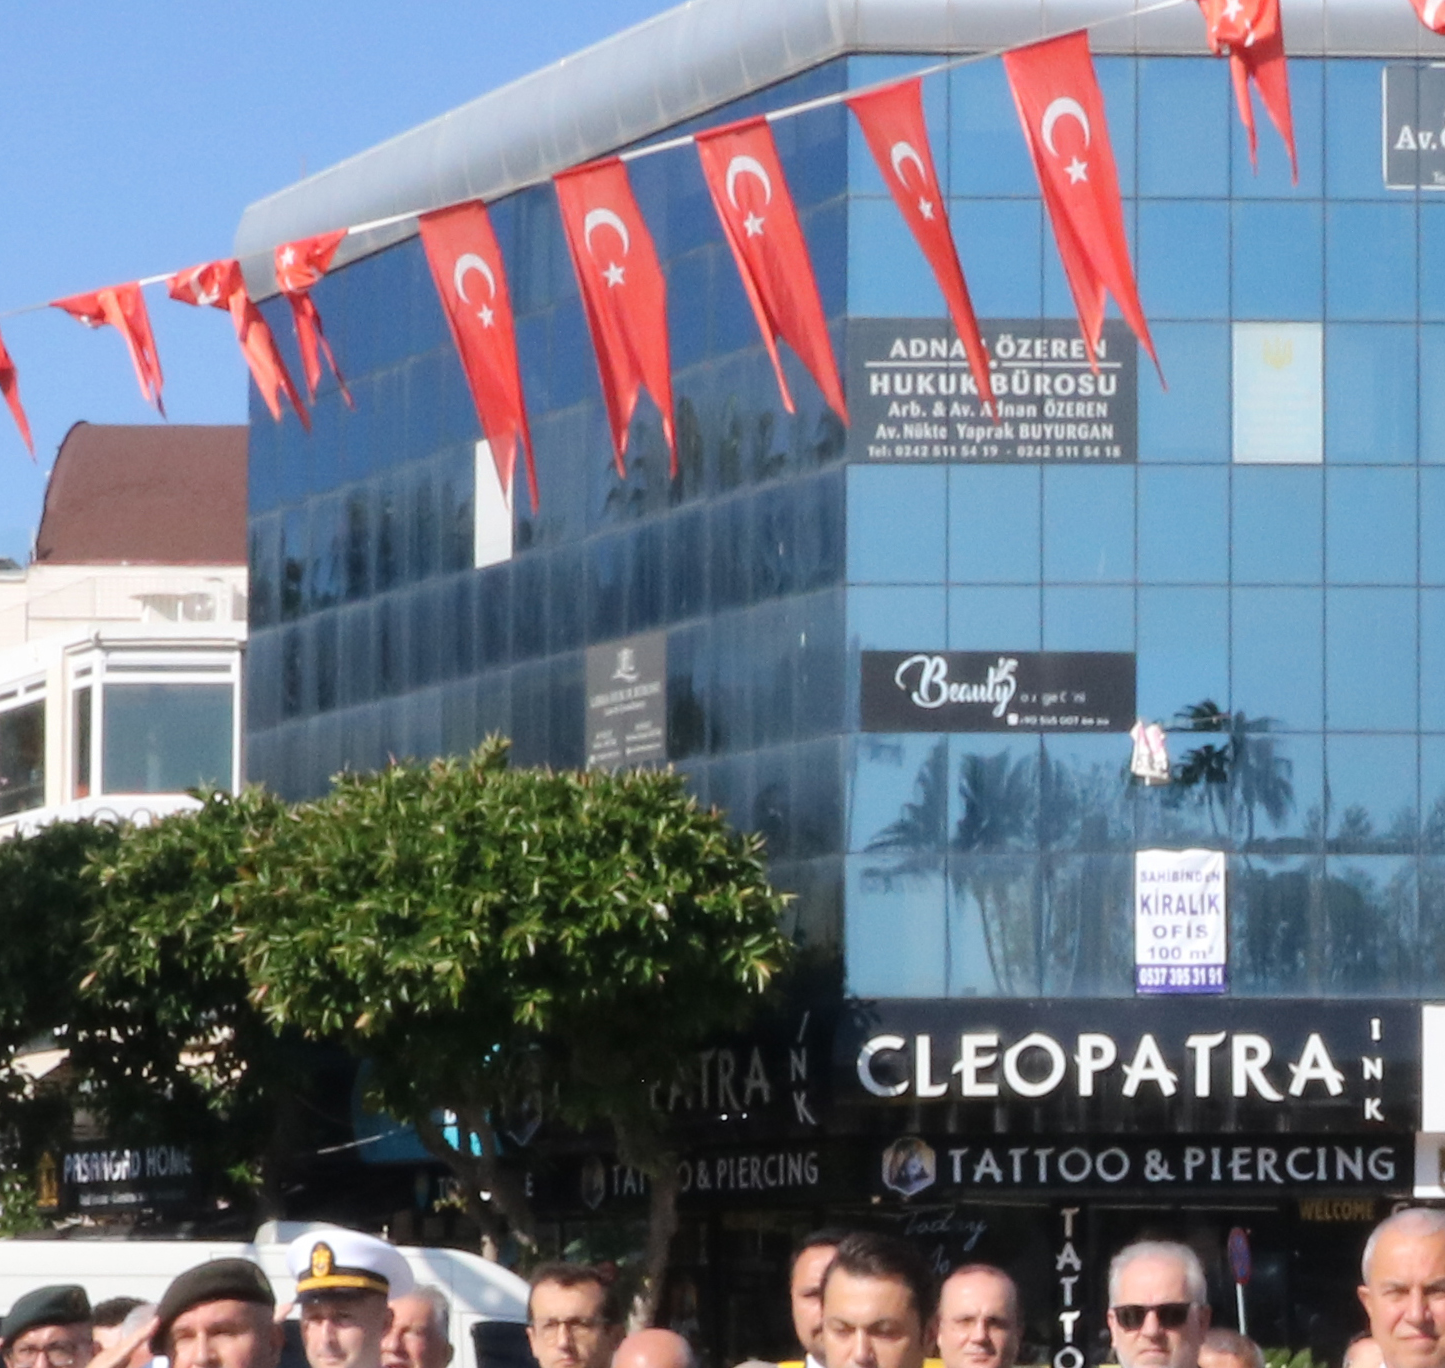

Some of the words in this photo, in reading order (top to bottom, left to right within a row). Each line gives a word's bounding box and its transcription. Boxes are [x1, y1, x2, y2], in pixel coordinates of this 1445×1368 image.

[869, 373, 980, 396] HUKUK
[989, 370, 1118, 396] BÜROSU
[887, 401, 926, 418] Arb.
[932, 401, 946, 417] &
[950, 402, 975, 417] Av.
[1044, 398, 1108, 418] ÖZEREN
[956, 424, 1015, 443] Yaprak
[1019, 424, 1114, 440] BUYURGAN
[895, 445, 929, 458] 0242
[932, 445, 956, 458] 511
[982, 445, 999, 458] 19
[1016, 445, 1051, 458] 0242
[894, 654, 1019, 718] Beauty
[1140, 889, 1221, 916] KİRALIK
[1152, 920, 1209, 939] OFİS
[1148, 946, 1182, 960] 100
[857, 1030, 1346, 1102] CLEOPATRA
[1362, 1017, 1385, 1122] INK
[696, 1160, 712, 1190] &
[716, 1152, 819, 1191] PIERCING
[949, 1147, 1130, 1184] TATTOO
[1143, 1149, 1176, 1182] &
[1183, 1147, 1397, 1184] PIERCING
[1299, 1199, 1374, 1221] WELCOME
